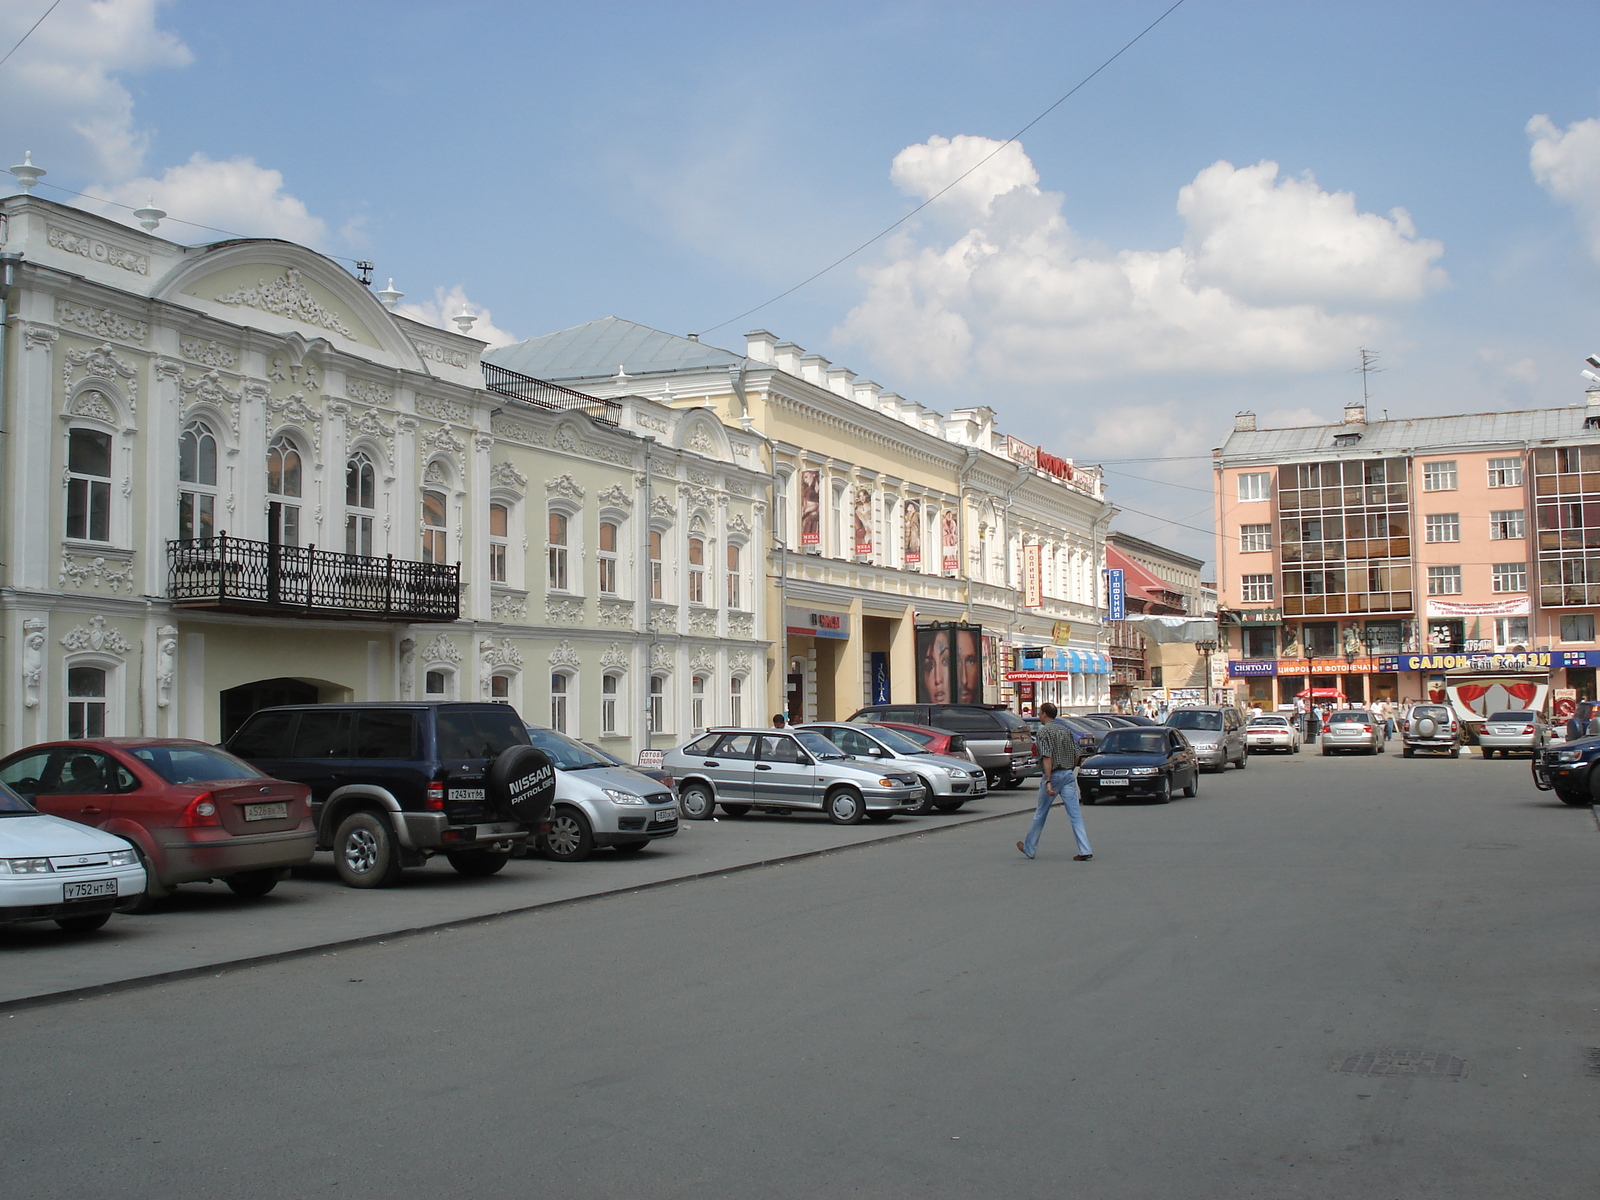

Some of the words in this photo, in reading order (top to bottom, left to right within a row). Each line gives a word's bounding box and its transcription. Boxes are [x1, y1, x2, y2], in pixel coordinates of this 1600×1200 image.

[1255, 613, 1282, 622] МЕХА
[1409, 655, 1467, 669] САЛОН
[509, 765, 552, 795] NISSAN
[511, 784, 542, 805] PATROL
